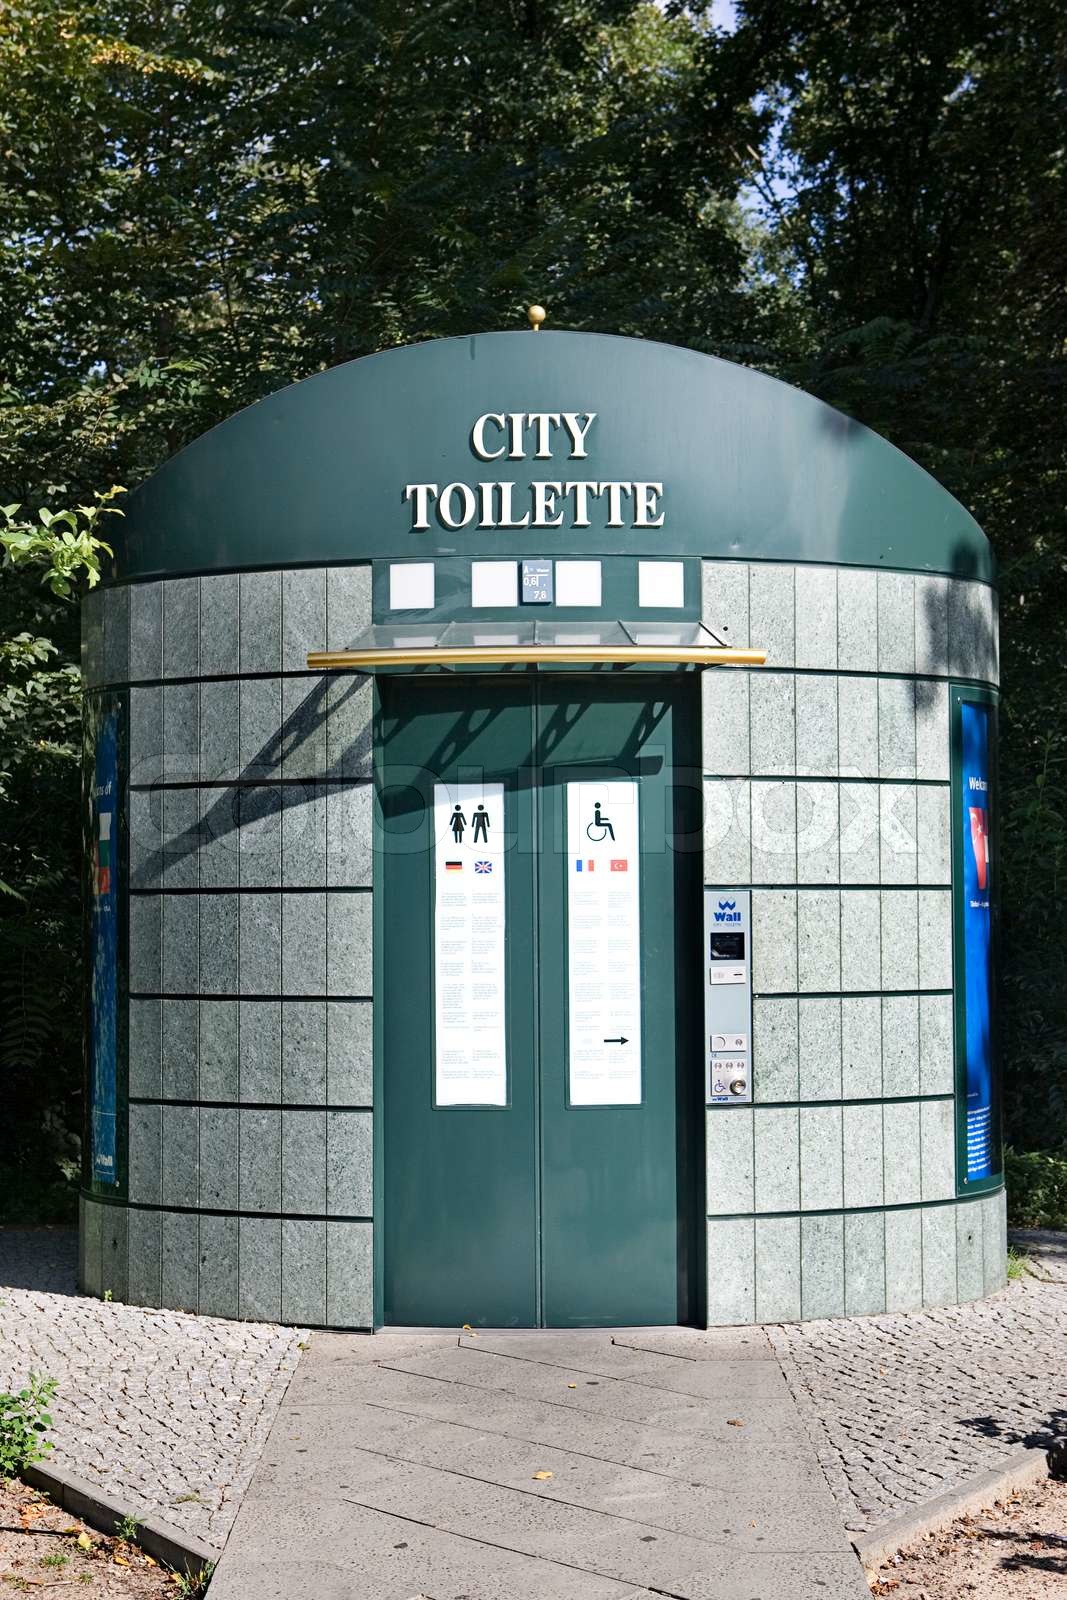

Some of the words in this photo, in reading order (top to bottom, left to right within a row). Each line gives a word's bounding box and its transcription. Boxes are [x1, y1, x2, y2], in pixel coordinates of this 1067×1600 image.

[471, 412, 597, 461] CITY
[402, 481, 666, 531] TOILETTE
[713, 911, 741, 922] Wall
